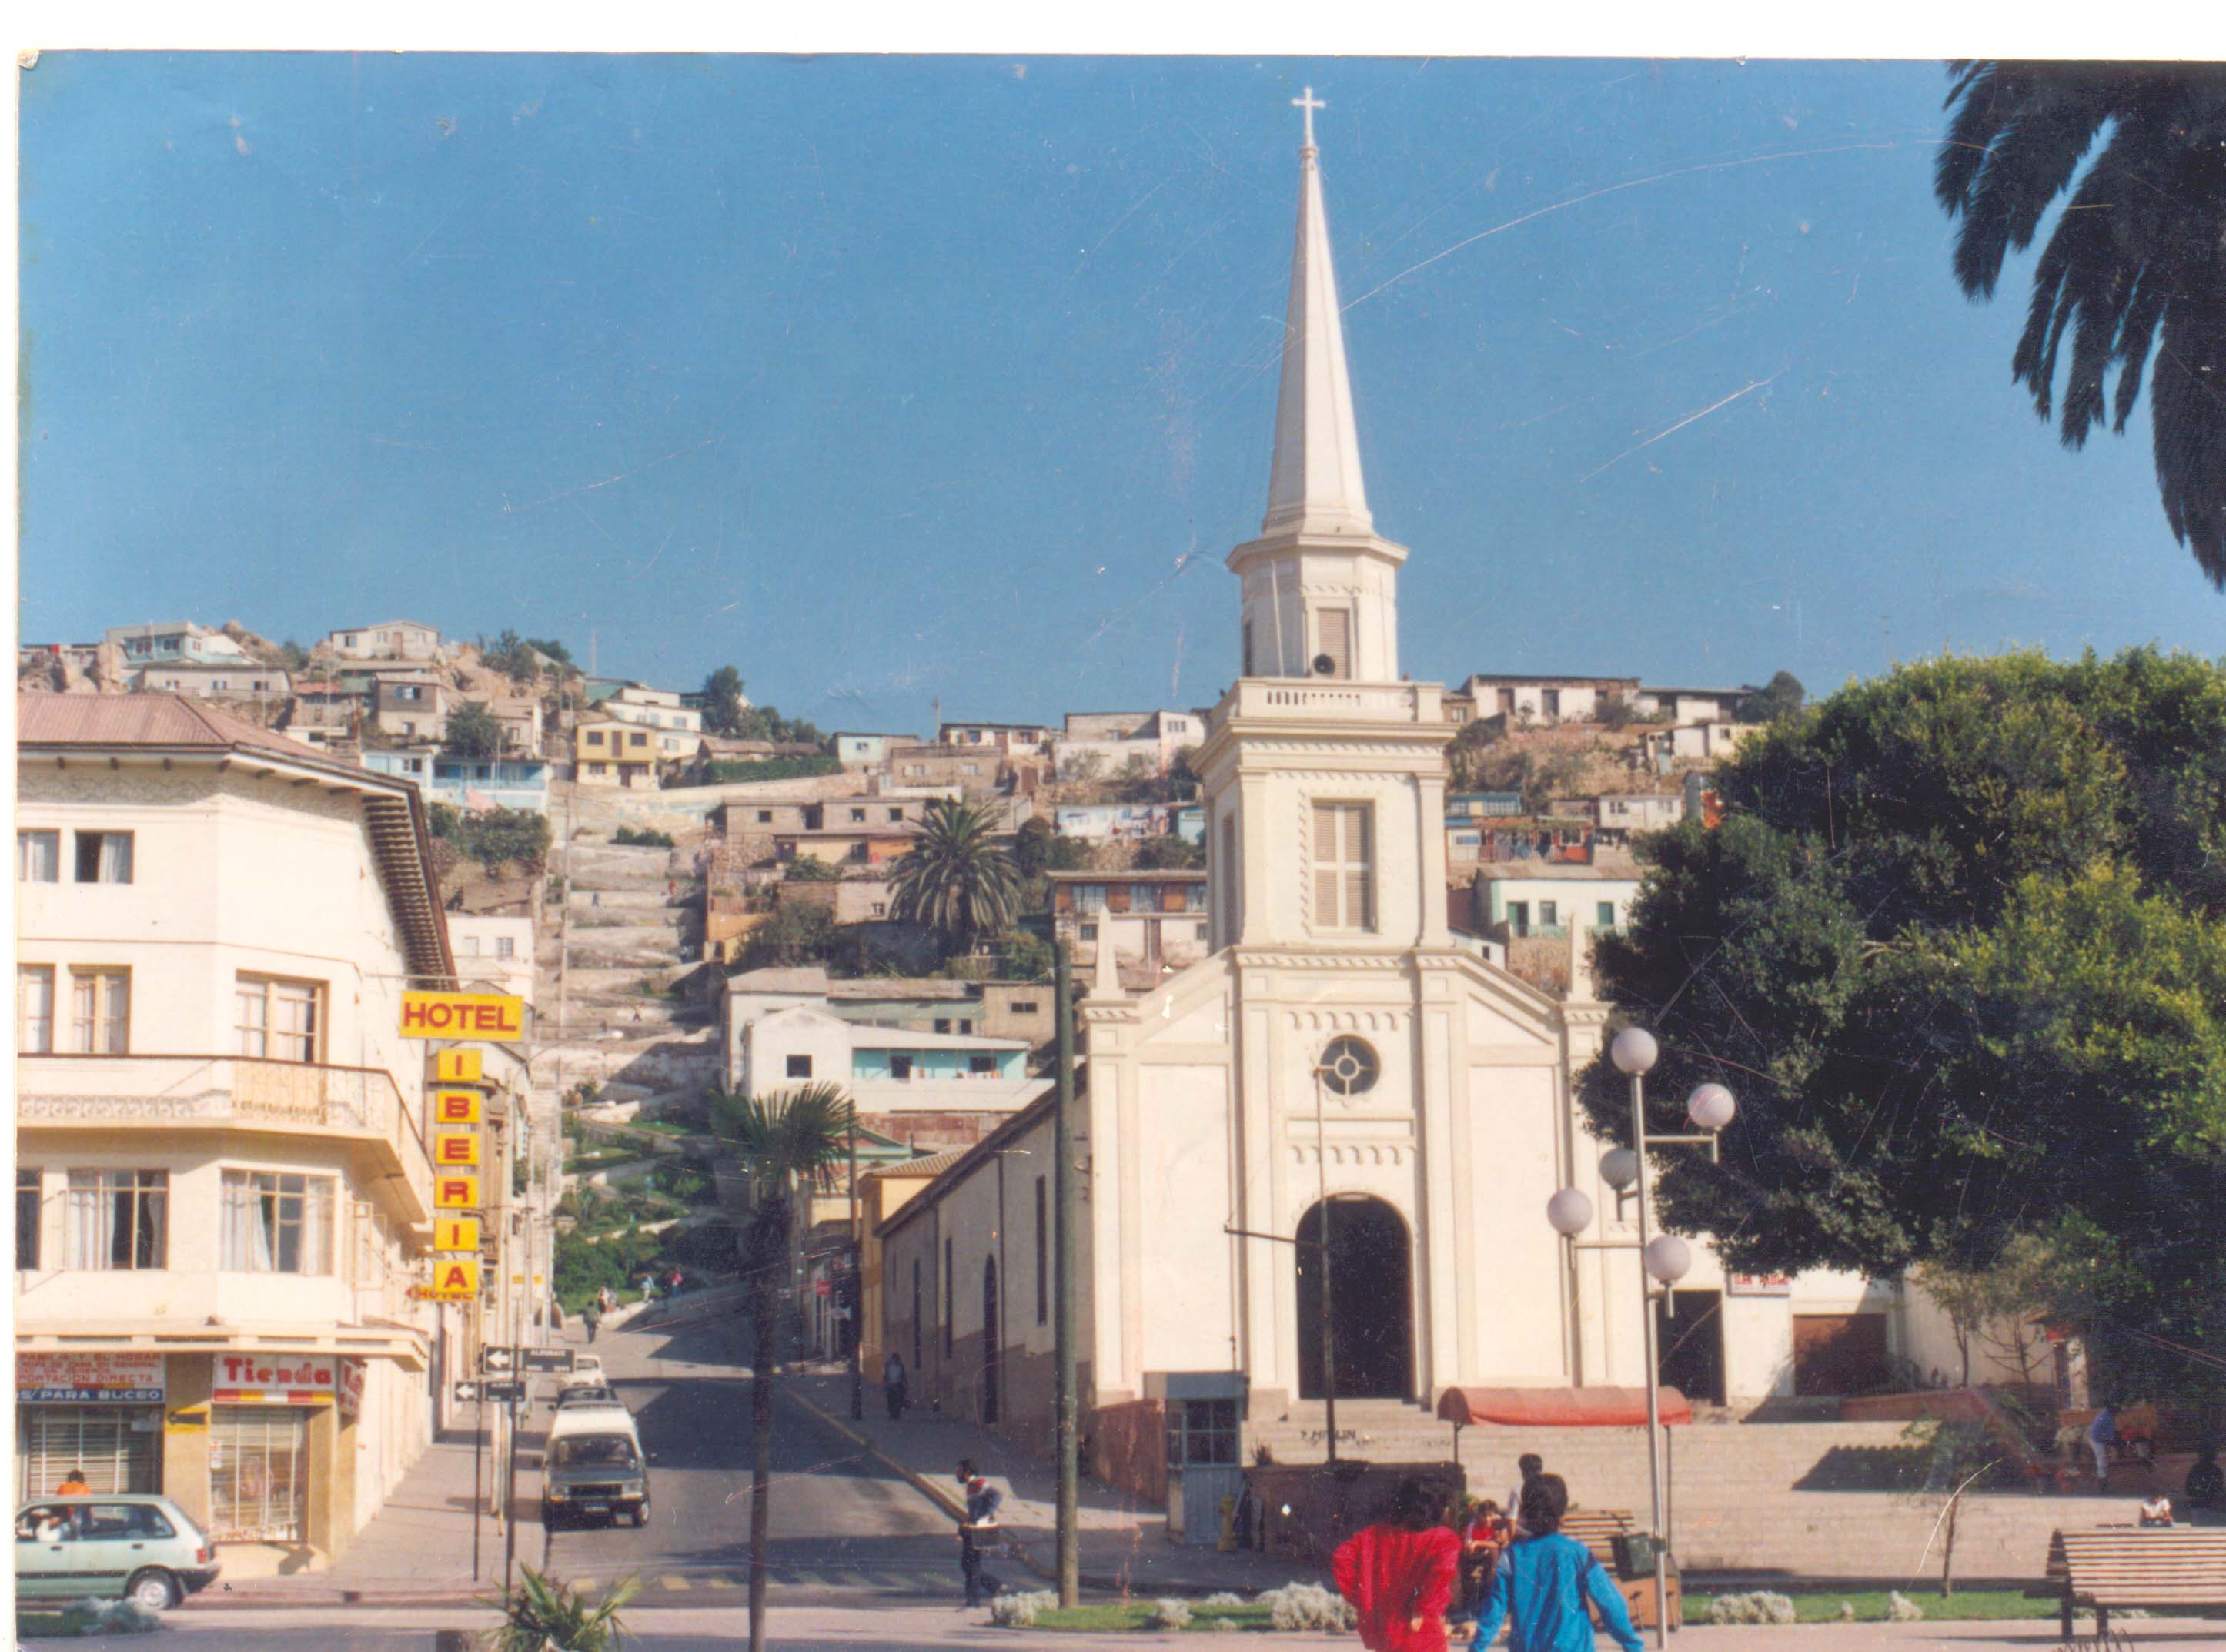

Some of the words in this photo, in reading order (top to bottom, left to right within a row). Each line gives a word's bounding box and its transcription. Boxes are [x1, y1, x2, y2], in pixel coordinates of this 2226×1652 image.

[403, 1002, 518, 1032] HOTEL
[443, 1054, 471, 1288] IBERIA
[223, 1356, 332, 1385] Tienda
[98, 1389, 160, 1400] BUCEO
